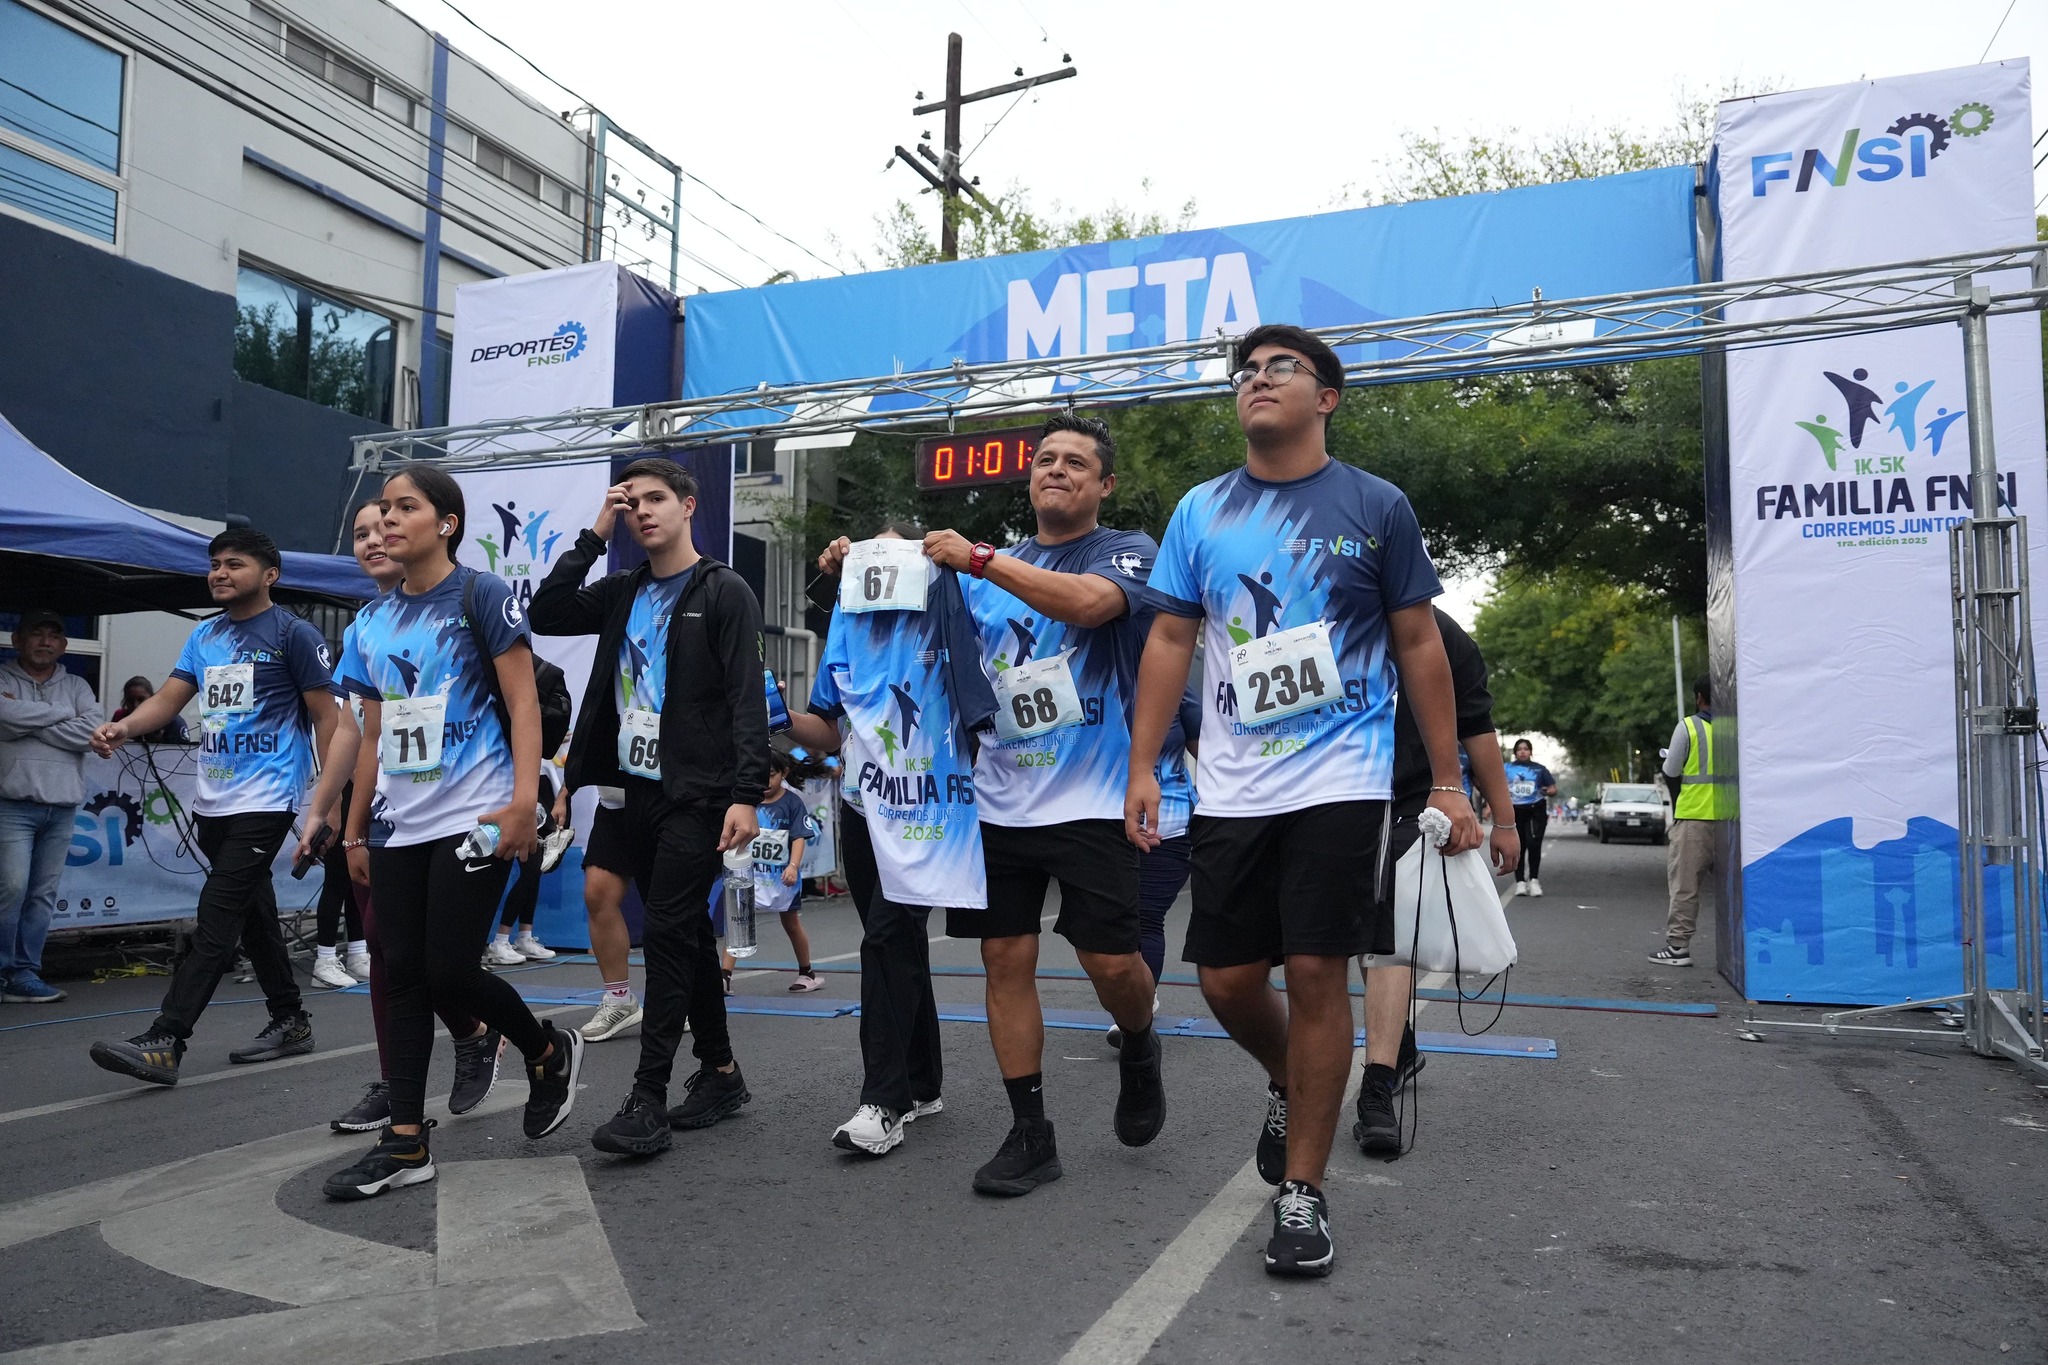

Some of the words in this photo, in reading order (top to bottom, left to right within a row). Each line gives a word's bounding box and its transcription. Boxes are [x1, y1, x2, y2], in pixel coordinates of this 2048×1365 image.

[1752, 128, 1927, 197] FNSI
[1007, 252, 1262, 386] META
[471, 335, 575, 362] DEPORTES
[527, 353, 565, 367] FNSI
[1757, 478, 1915, 520] FAMILIA
[1802, 519, 1896, 538] CORREMOS
[1836, 540, 1859, 548] 1ra.
[1860, 536, 1900, 547] edición
[1901, 536, 1929, 546] 2025
[864, 565, 899, 601] 67
[207, 682, 244, 709] 642
[1248, 656, 1325, 713] 234
[1011, 687, 1058, 729] 68
[234, 733, 279, 754] FNSI
[393, 726, 428, 763] 71
[629, 735, 660, 771] 69
[1260, 739, 1308, 757] 2025
[1015, 751, 1057, 767] 2025
[207, 768, 234, 780] 2025
[412, 769, 442, 784] 2025
[858, 761, 940, 806] FAMILIA
[878, 803, 929, 822] CORREMOS
[902, 825, 945, 841] 2025
[751, 841, 784, 861] 562
